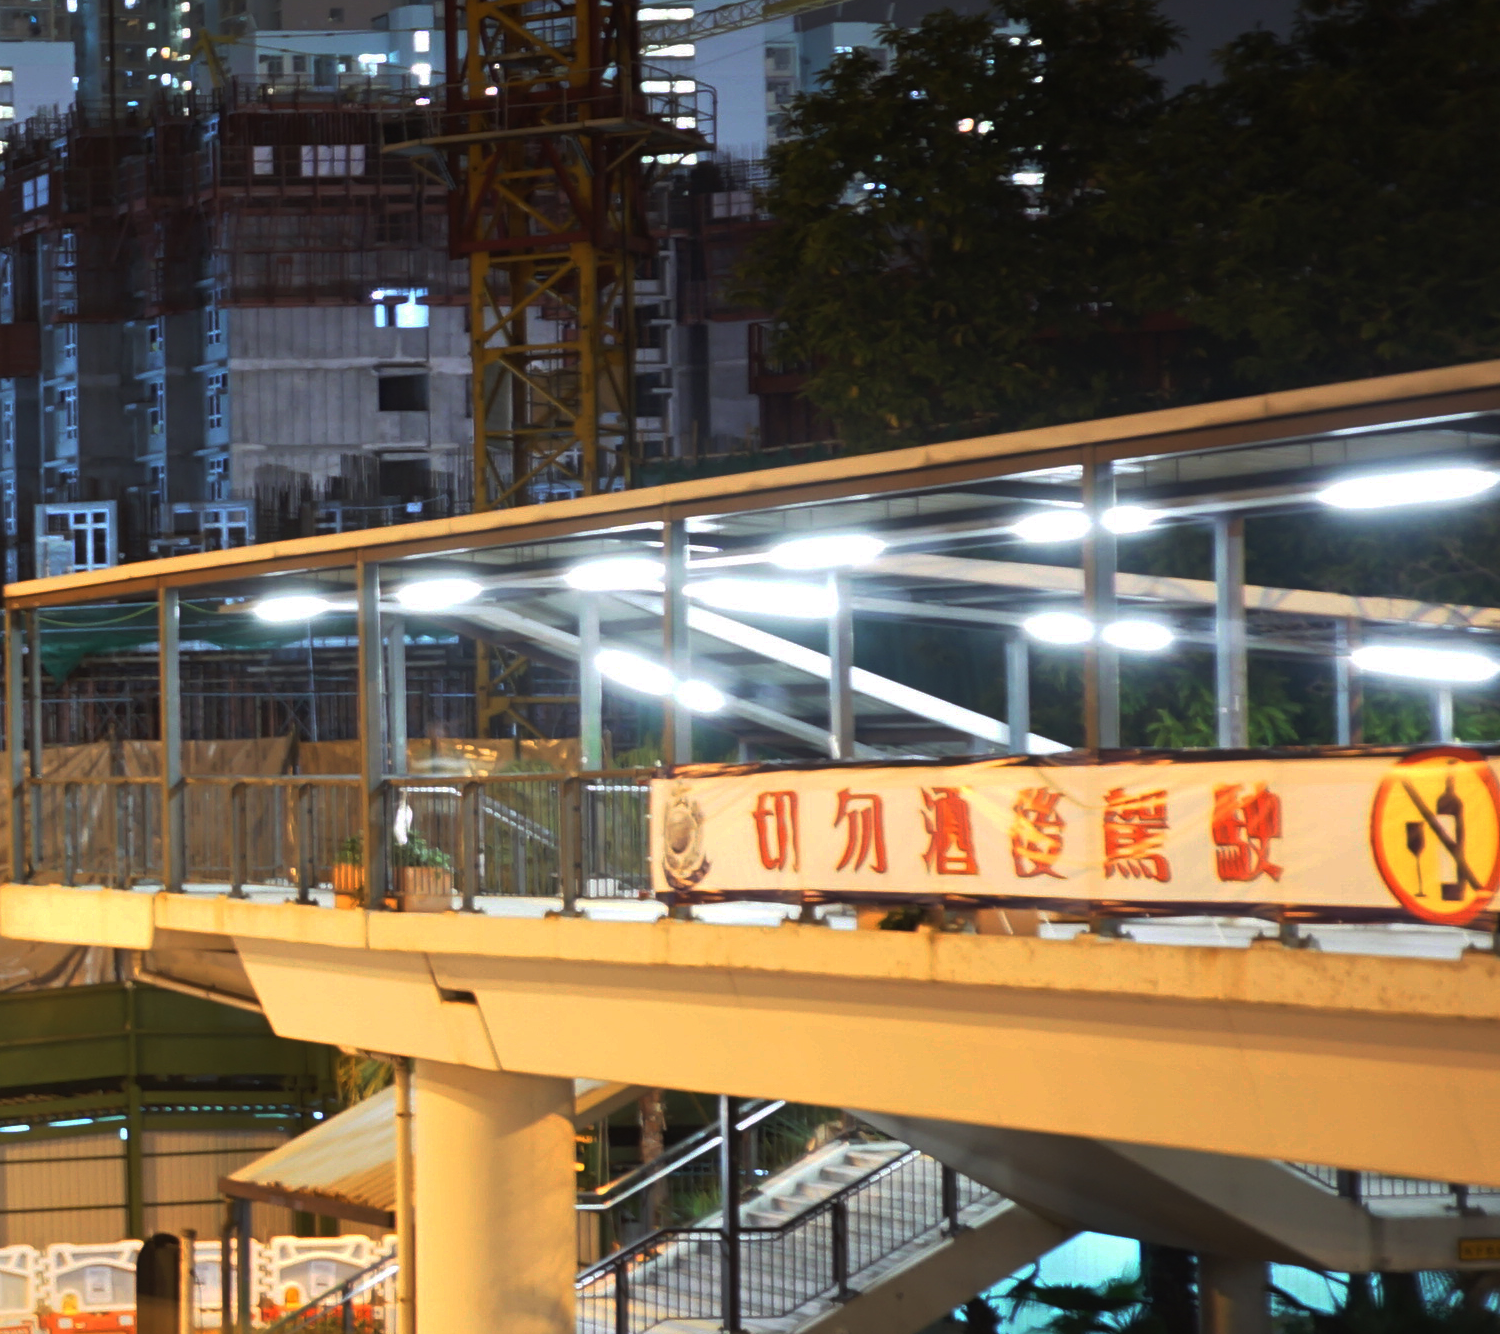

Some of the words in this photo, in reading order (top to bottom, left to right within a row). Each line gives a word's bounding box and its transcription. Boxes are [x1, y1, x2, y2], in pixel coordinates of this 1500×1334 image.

[753, 781, 1283, 883] 切勿酒後駕駛
